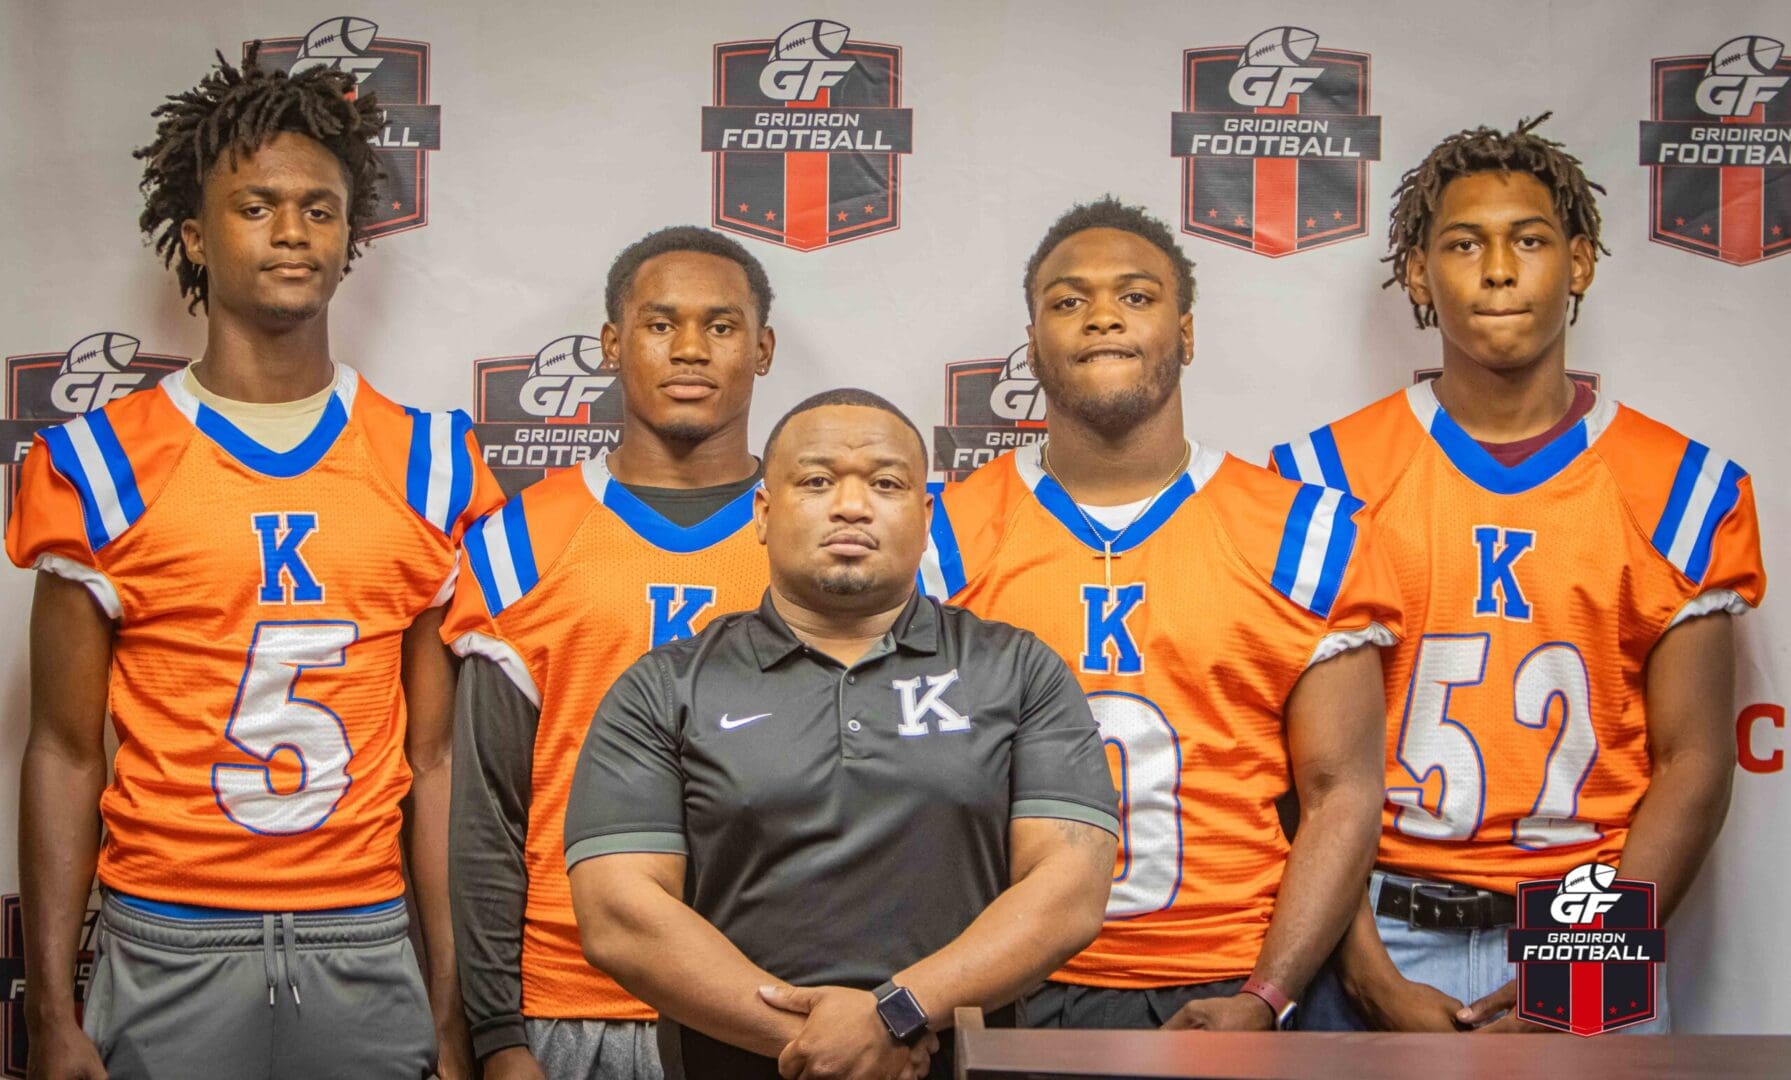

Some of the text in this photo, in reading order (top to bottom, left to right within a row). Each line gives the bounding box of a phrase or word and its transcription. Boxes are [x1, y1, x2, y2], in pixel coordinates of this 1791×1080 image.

[759, 60, 856, 100] GF
[1228, 66, 1325, 107] GF
[1695, 75, 1791, 116] GF
[721, 128, 892, 151] FOOTBALL
[754, 112, 860, 127] GRIDIRON
[1224, 118, 1329, 134] GRIDIRON
[1191, 133, 1361, 158] FOOTBALL
[1658, 143, 1791, 165] FOOTBA
[50, 372, 147, 413] GF
[519, 376, 617, 416] GF
[482, 444, 612, 466] FOOTBA
[515, 428, 620, 443] GRIDIRON
[251, 512, 326, 606] K
[1472, 524, 1537, 622] K
[646, 583, 717, 652] K
[1080, 583, 1146, 676] K
[892, 668, 971, 737] K
[211, 620, 358, 836] 5
[1387, 632, 1605, 851] 52
[1735, 703, 1785, 774] C
